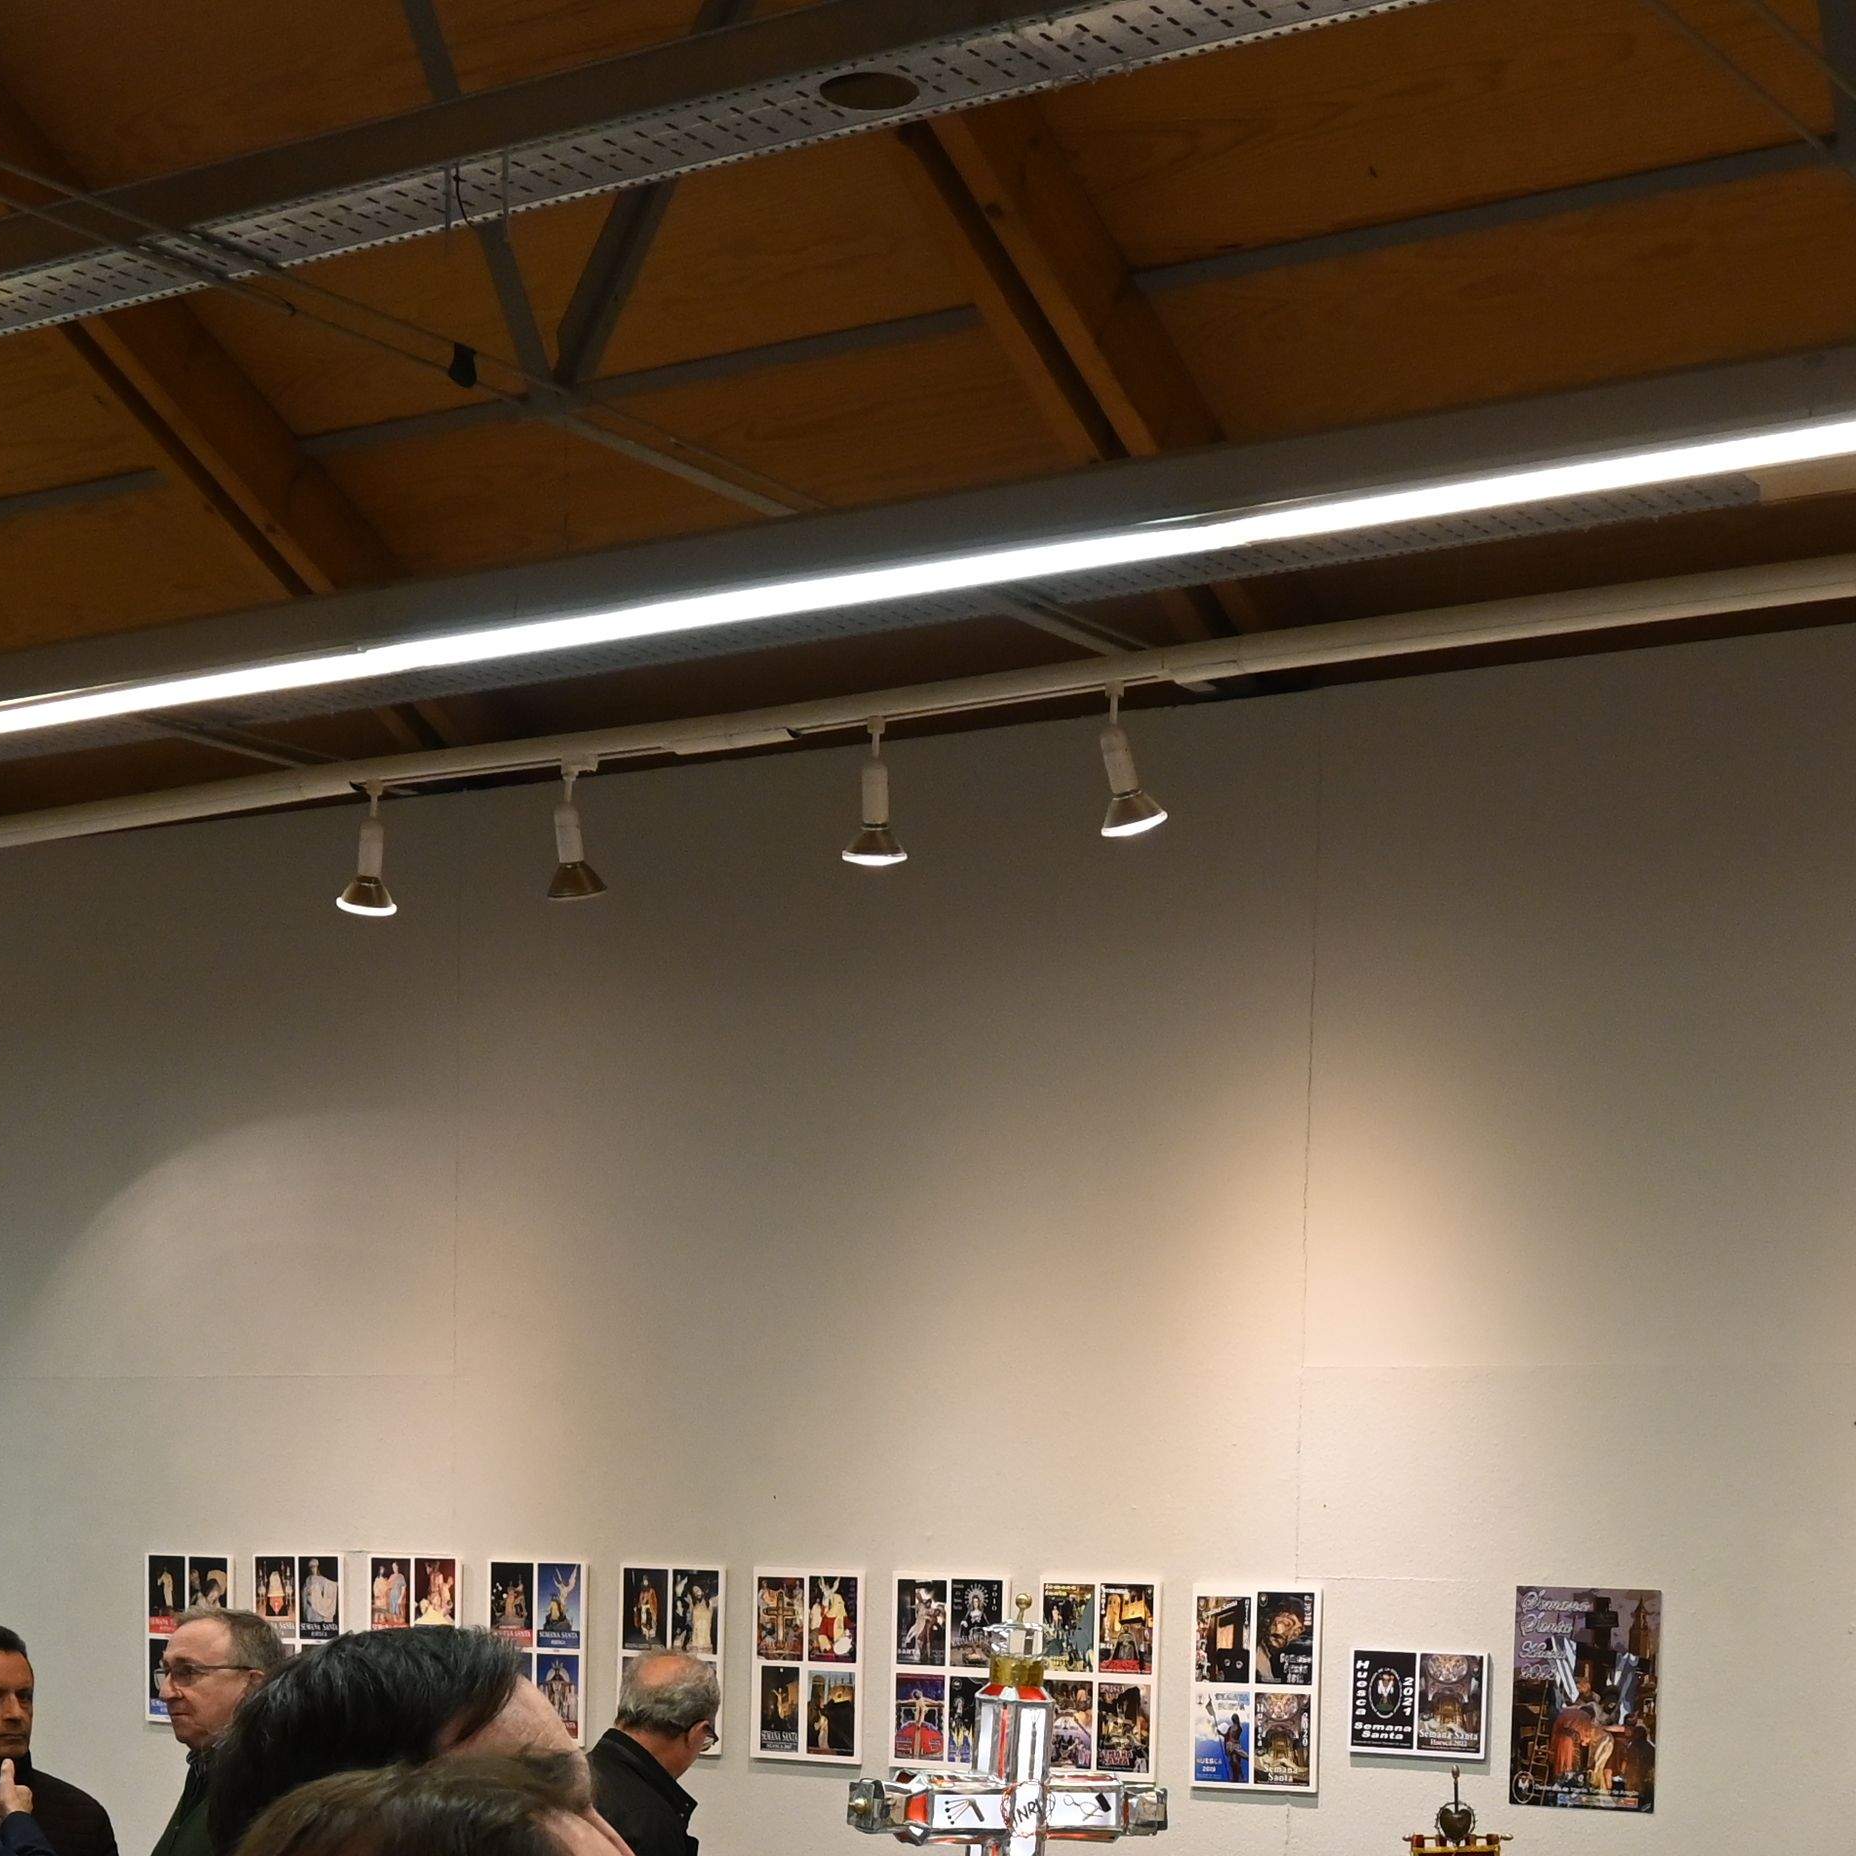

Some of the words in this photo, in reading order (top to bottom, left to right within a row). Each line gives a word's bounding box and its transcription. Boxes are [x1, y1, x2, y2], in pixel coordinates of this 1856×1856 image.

[1356, 1660, 1370, 1716] Huesca
[1402, 1677, 1414, 1716] 2021
[1353, 1721, 1413, 1733] Semana
[1361, 1730, 1404, 1740] Santa
